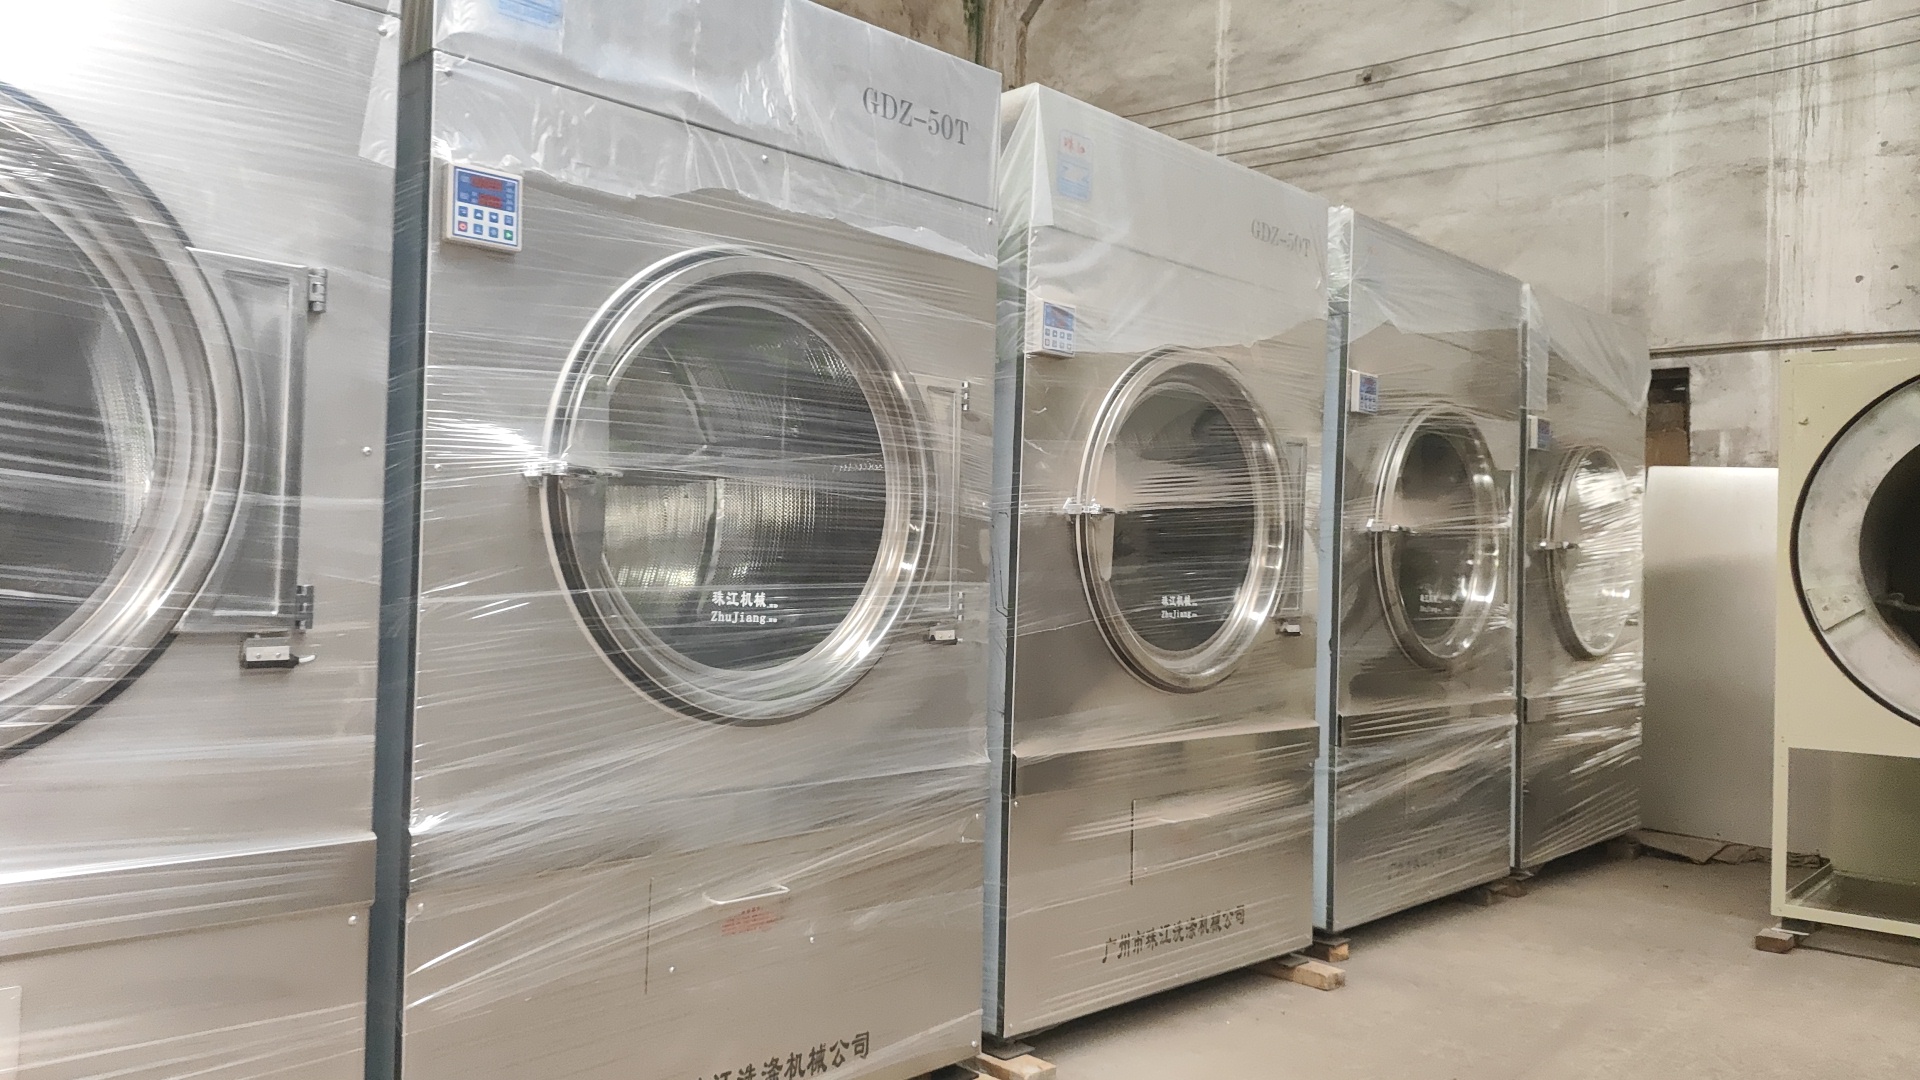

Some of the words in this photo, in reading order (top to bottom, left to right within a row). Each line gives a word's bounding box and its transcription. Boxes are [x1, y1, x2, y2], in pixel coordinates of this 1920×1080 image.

[863, 87, 969, 145] GDZ-50T
[1251, 219, 1310, 257] GDZ-50T
[710, 610, 767, 624] ZhuJiang
[711, 590, 767, 607] 珠江机械
[1101, 904, 1245, 963] 广州市珠江洗涤机械公司
[699, 1030, 870, 1080] 洗涤机械公司
